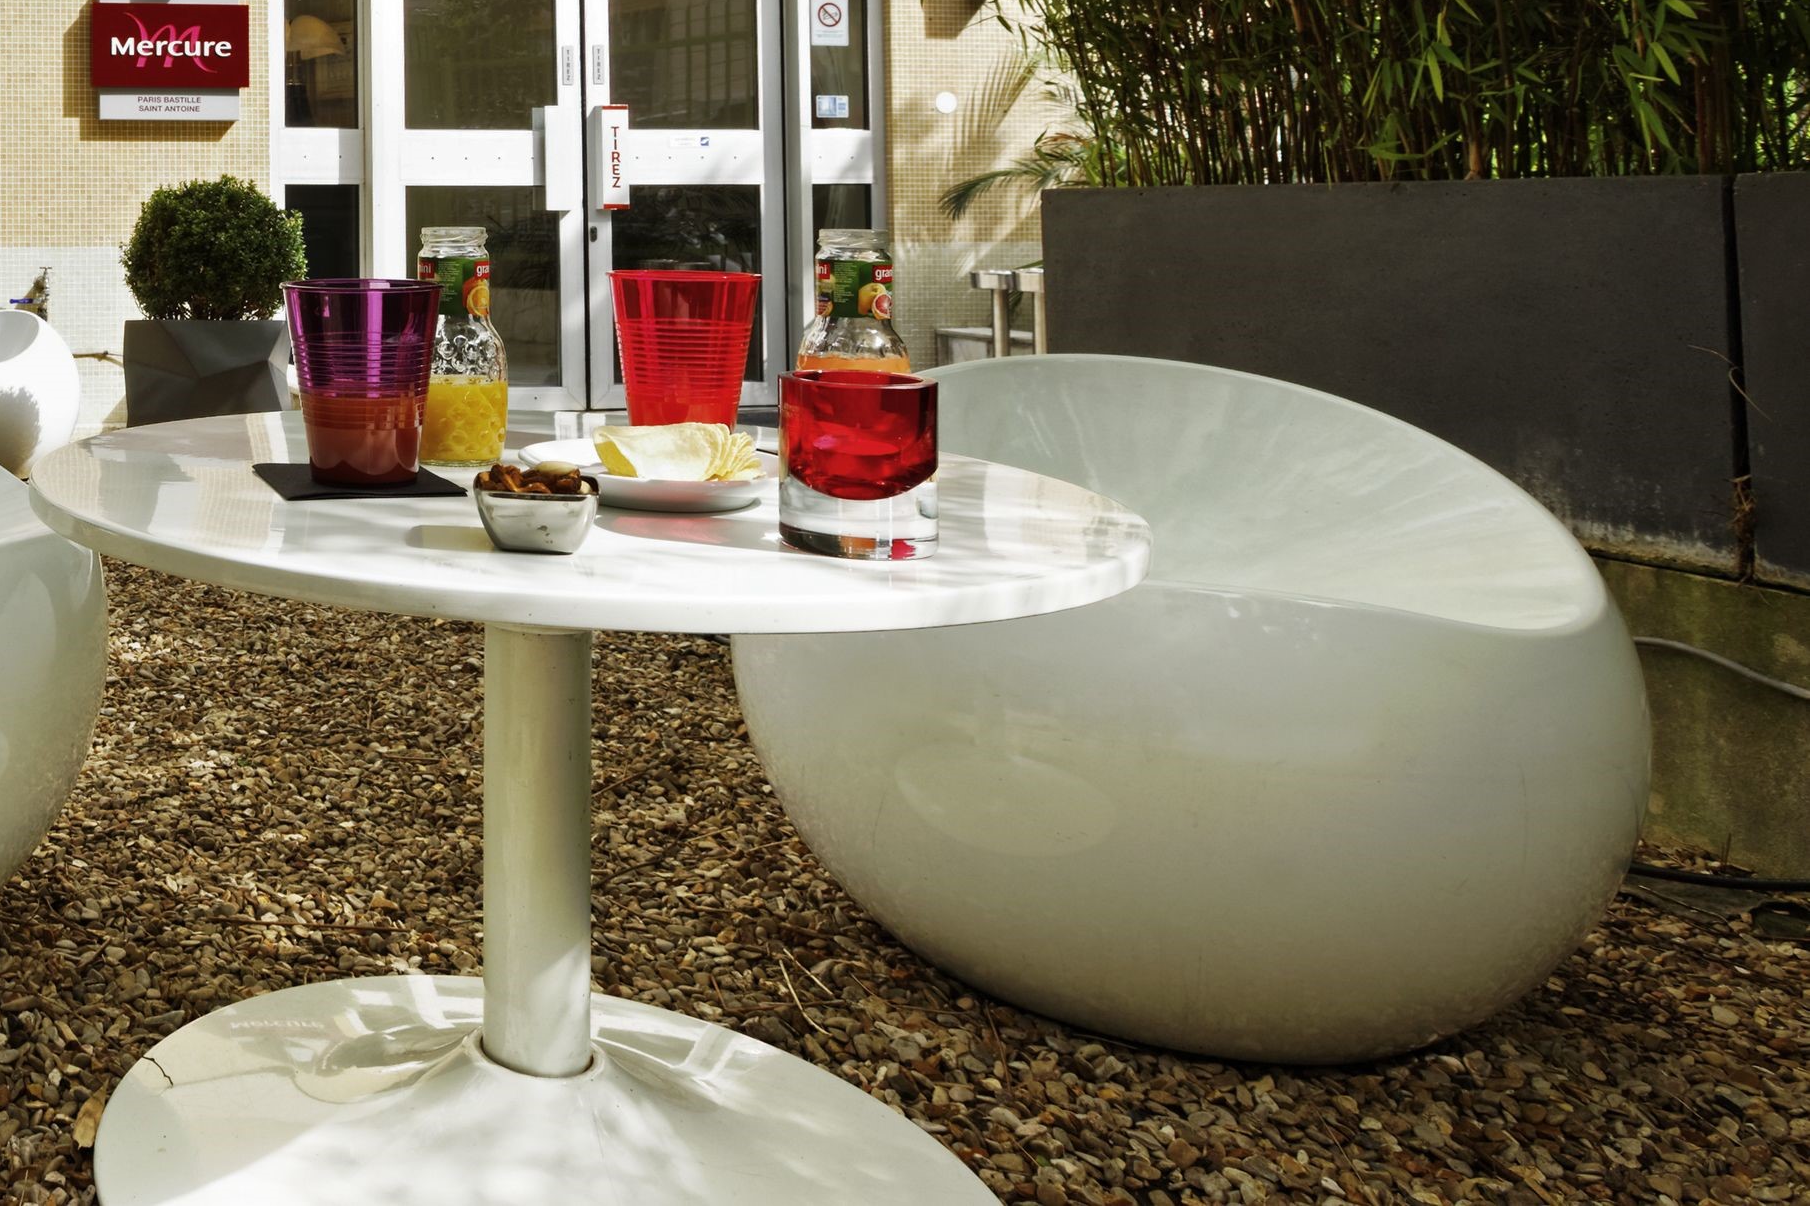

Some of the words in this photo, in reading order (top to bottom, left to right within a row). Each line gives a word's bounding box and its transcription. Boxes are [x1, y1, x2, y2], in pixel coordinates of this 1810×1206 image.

[110, 36, 233, 57] Mercure
[137, 96, 162, 104] PARIS
[611, 126, 621, 188] TIREZ
